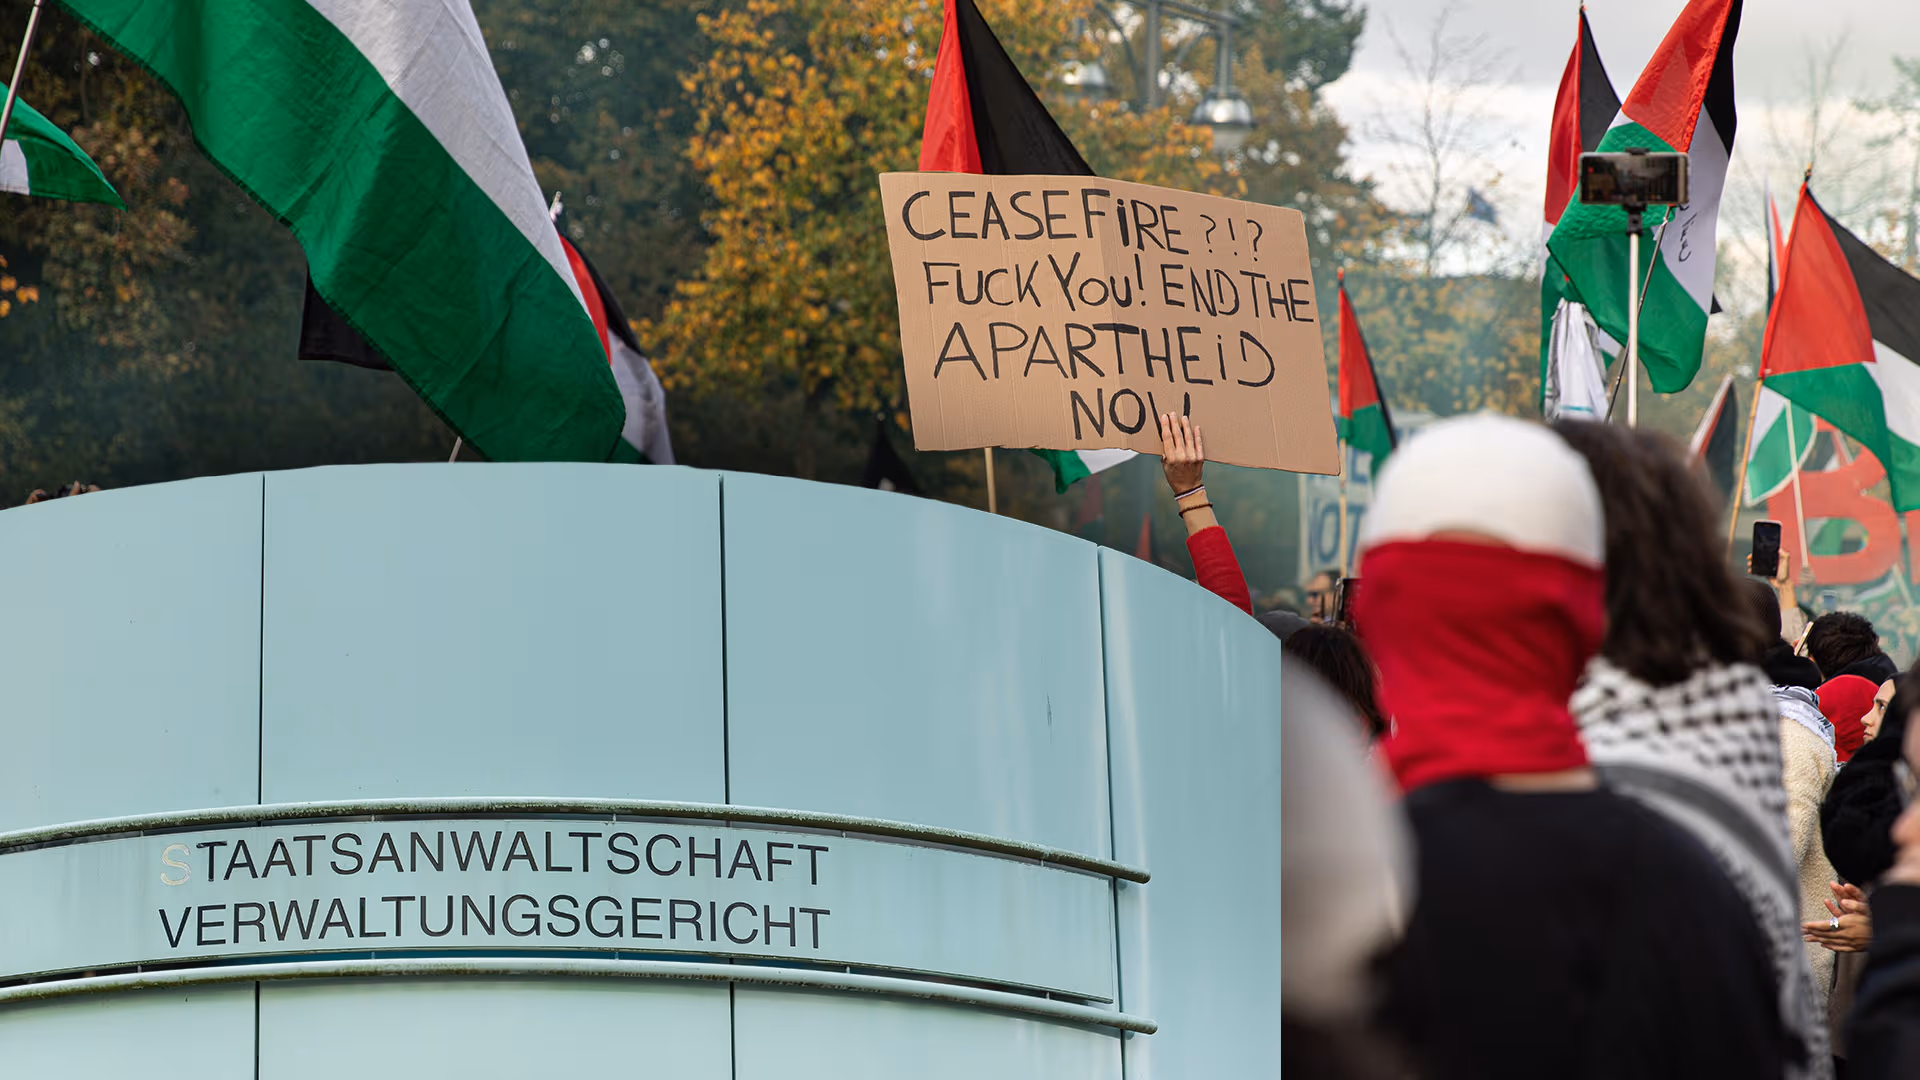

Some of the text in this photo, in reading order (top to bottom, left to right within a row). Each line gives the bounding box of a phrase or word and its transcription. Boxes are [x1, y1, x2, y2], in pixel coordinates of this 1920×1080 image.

[922, 260, 1041, 308] FUCK
[1160, 263, 1241, 317] END
[1239, 269, 1315, 322] THE
[159, 830, 830, 886] STAATSANWALTSCHAFT
[158, 893, 831, 949] VERWALTUNGSGERICHT
